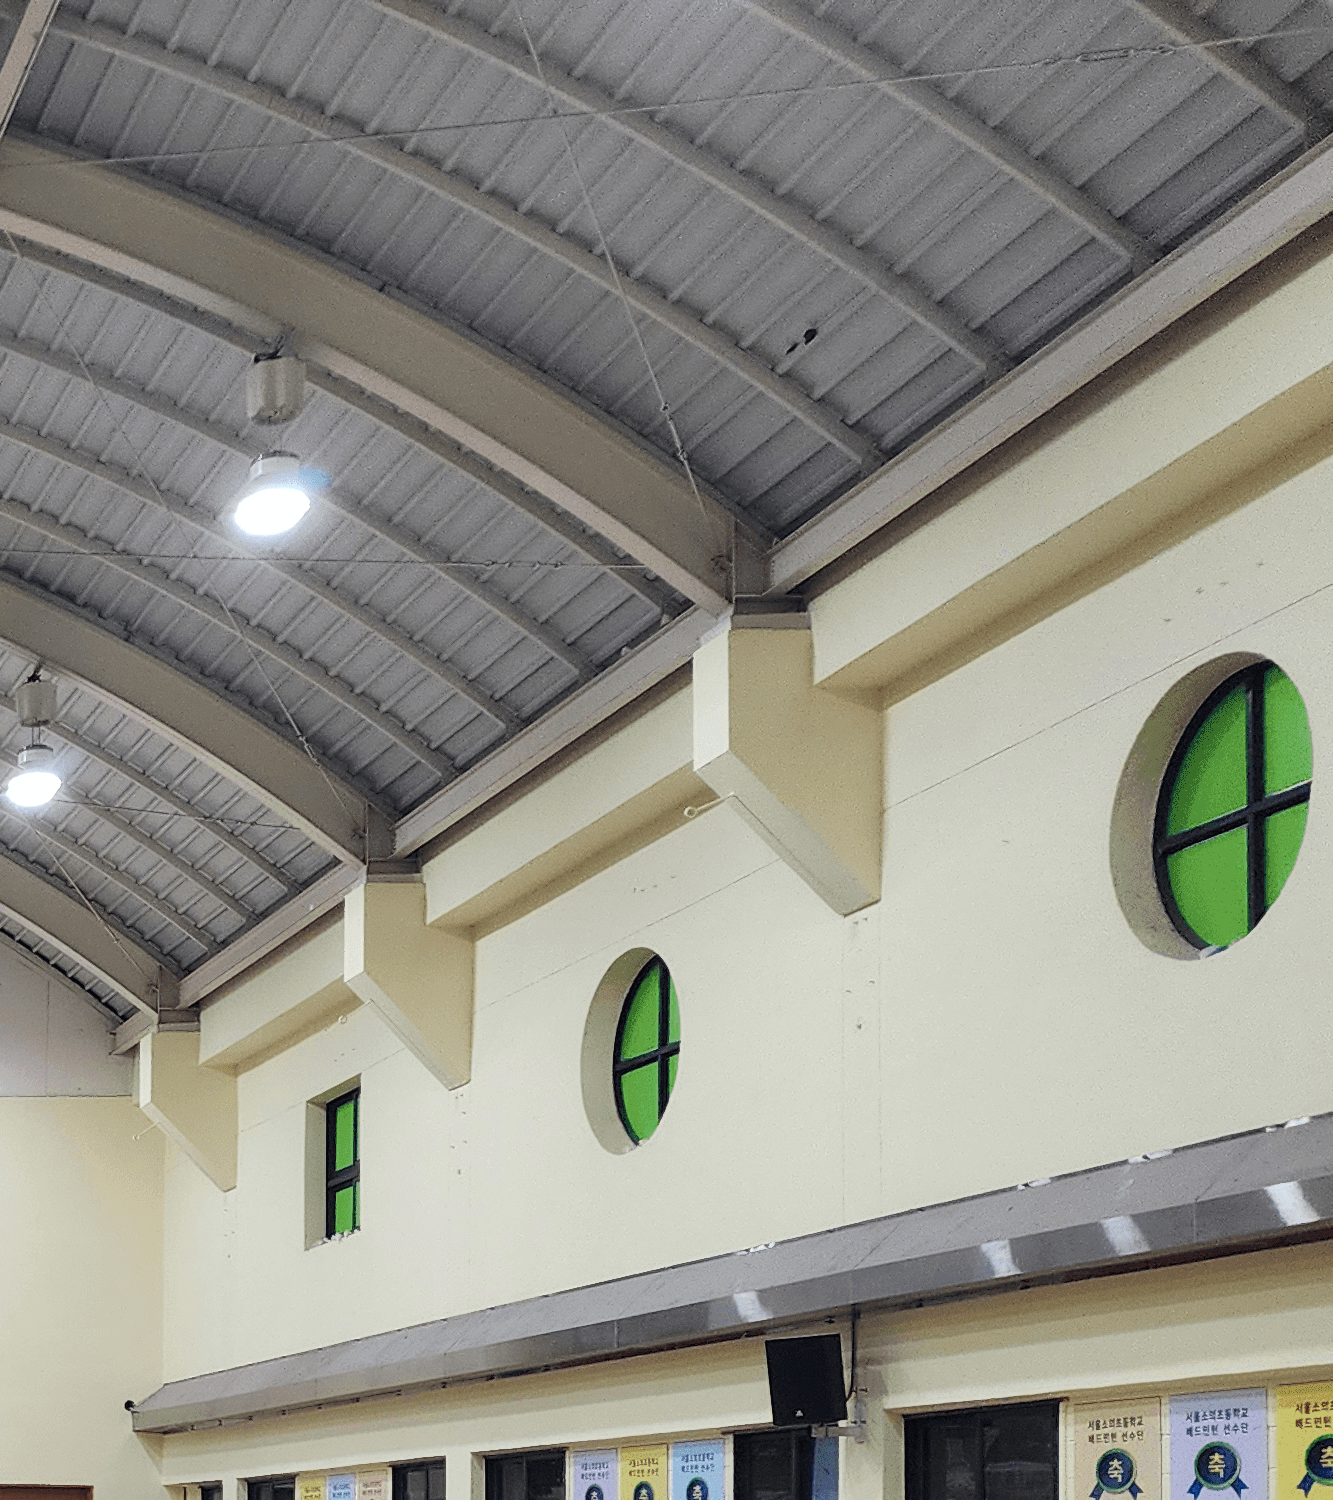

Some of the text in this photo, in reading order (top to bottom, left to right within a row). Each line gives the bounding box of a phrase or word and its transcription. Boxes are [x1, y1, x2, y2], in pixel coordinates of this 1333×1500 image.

[1186, 1407, 1249, 1423] 서울소의초등학교
[1087, 1416, 1144, 1431] 서울소의초등학교
[1186, 1422, 1249, 1438] 배드민턴 선수단
[1088, 1430, 1144, 1444] 배드민턴 선수단
[1107, 1458, 1124, 1483] 축
[1208, 1452, 1226, 1479] 축
